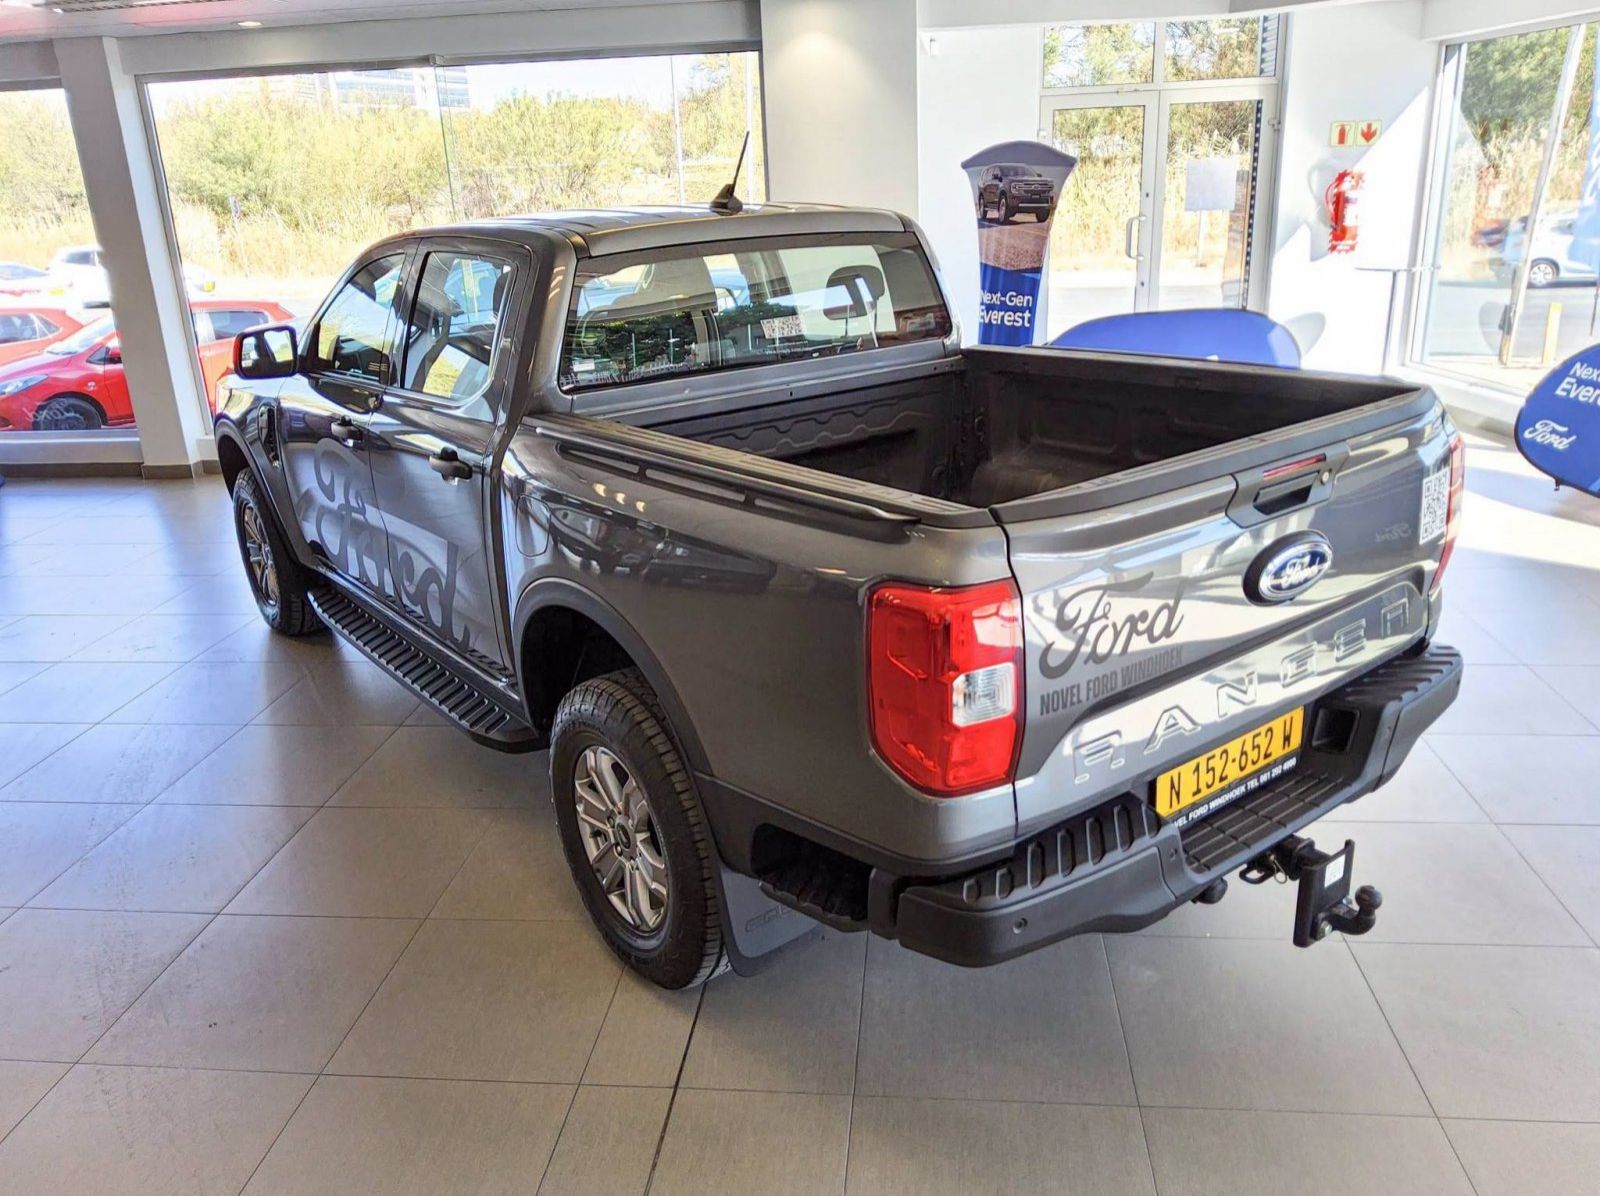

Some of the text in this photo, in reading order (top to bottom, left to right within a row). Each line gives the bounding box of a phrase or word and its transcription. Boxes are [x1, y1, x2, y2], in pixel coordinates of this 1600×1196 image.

[980, 289, 1033, 307] Next-Gen
[980, 305, 1031, 328] Everest
[1523, 419, 1577, 450] Ford
[313, 437, 471, 652] Ford
[1280, 553, 1321, 590] Ford
[1039, 571, 1188, 680] Ford
[1039, 645, 1184, 716] NOVEL FORD WINDHOEK
[1168, 715, 1294, 809] N 152-652 W
[1188, 803, 1209, 822] FORD
[1209, 783, 1247, 810] WINDHOEK
[1246, 778, 1260, 791] TEL
